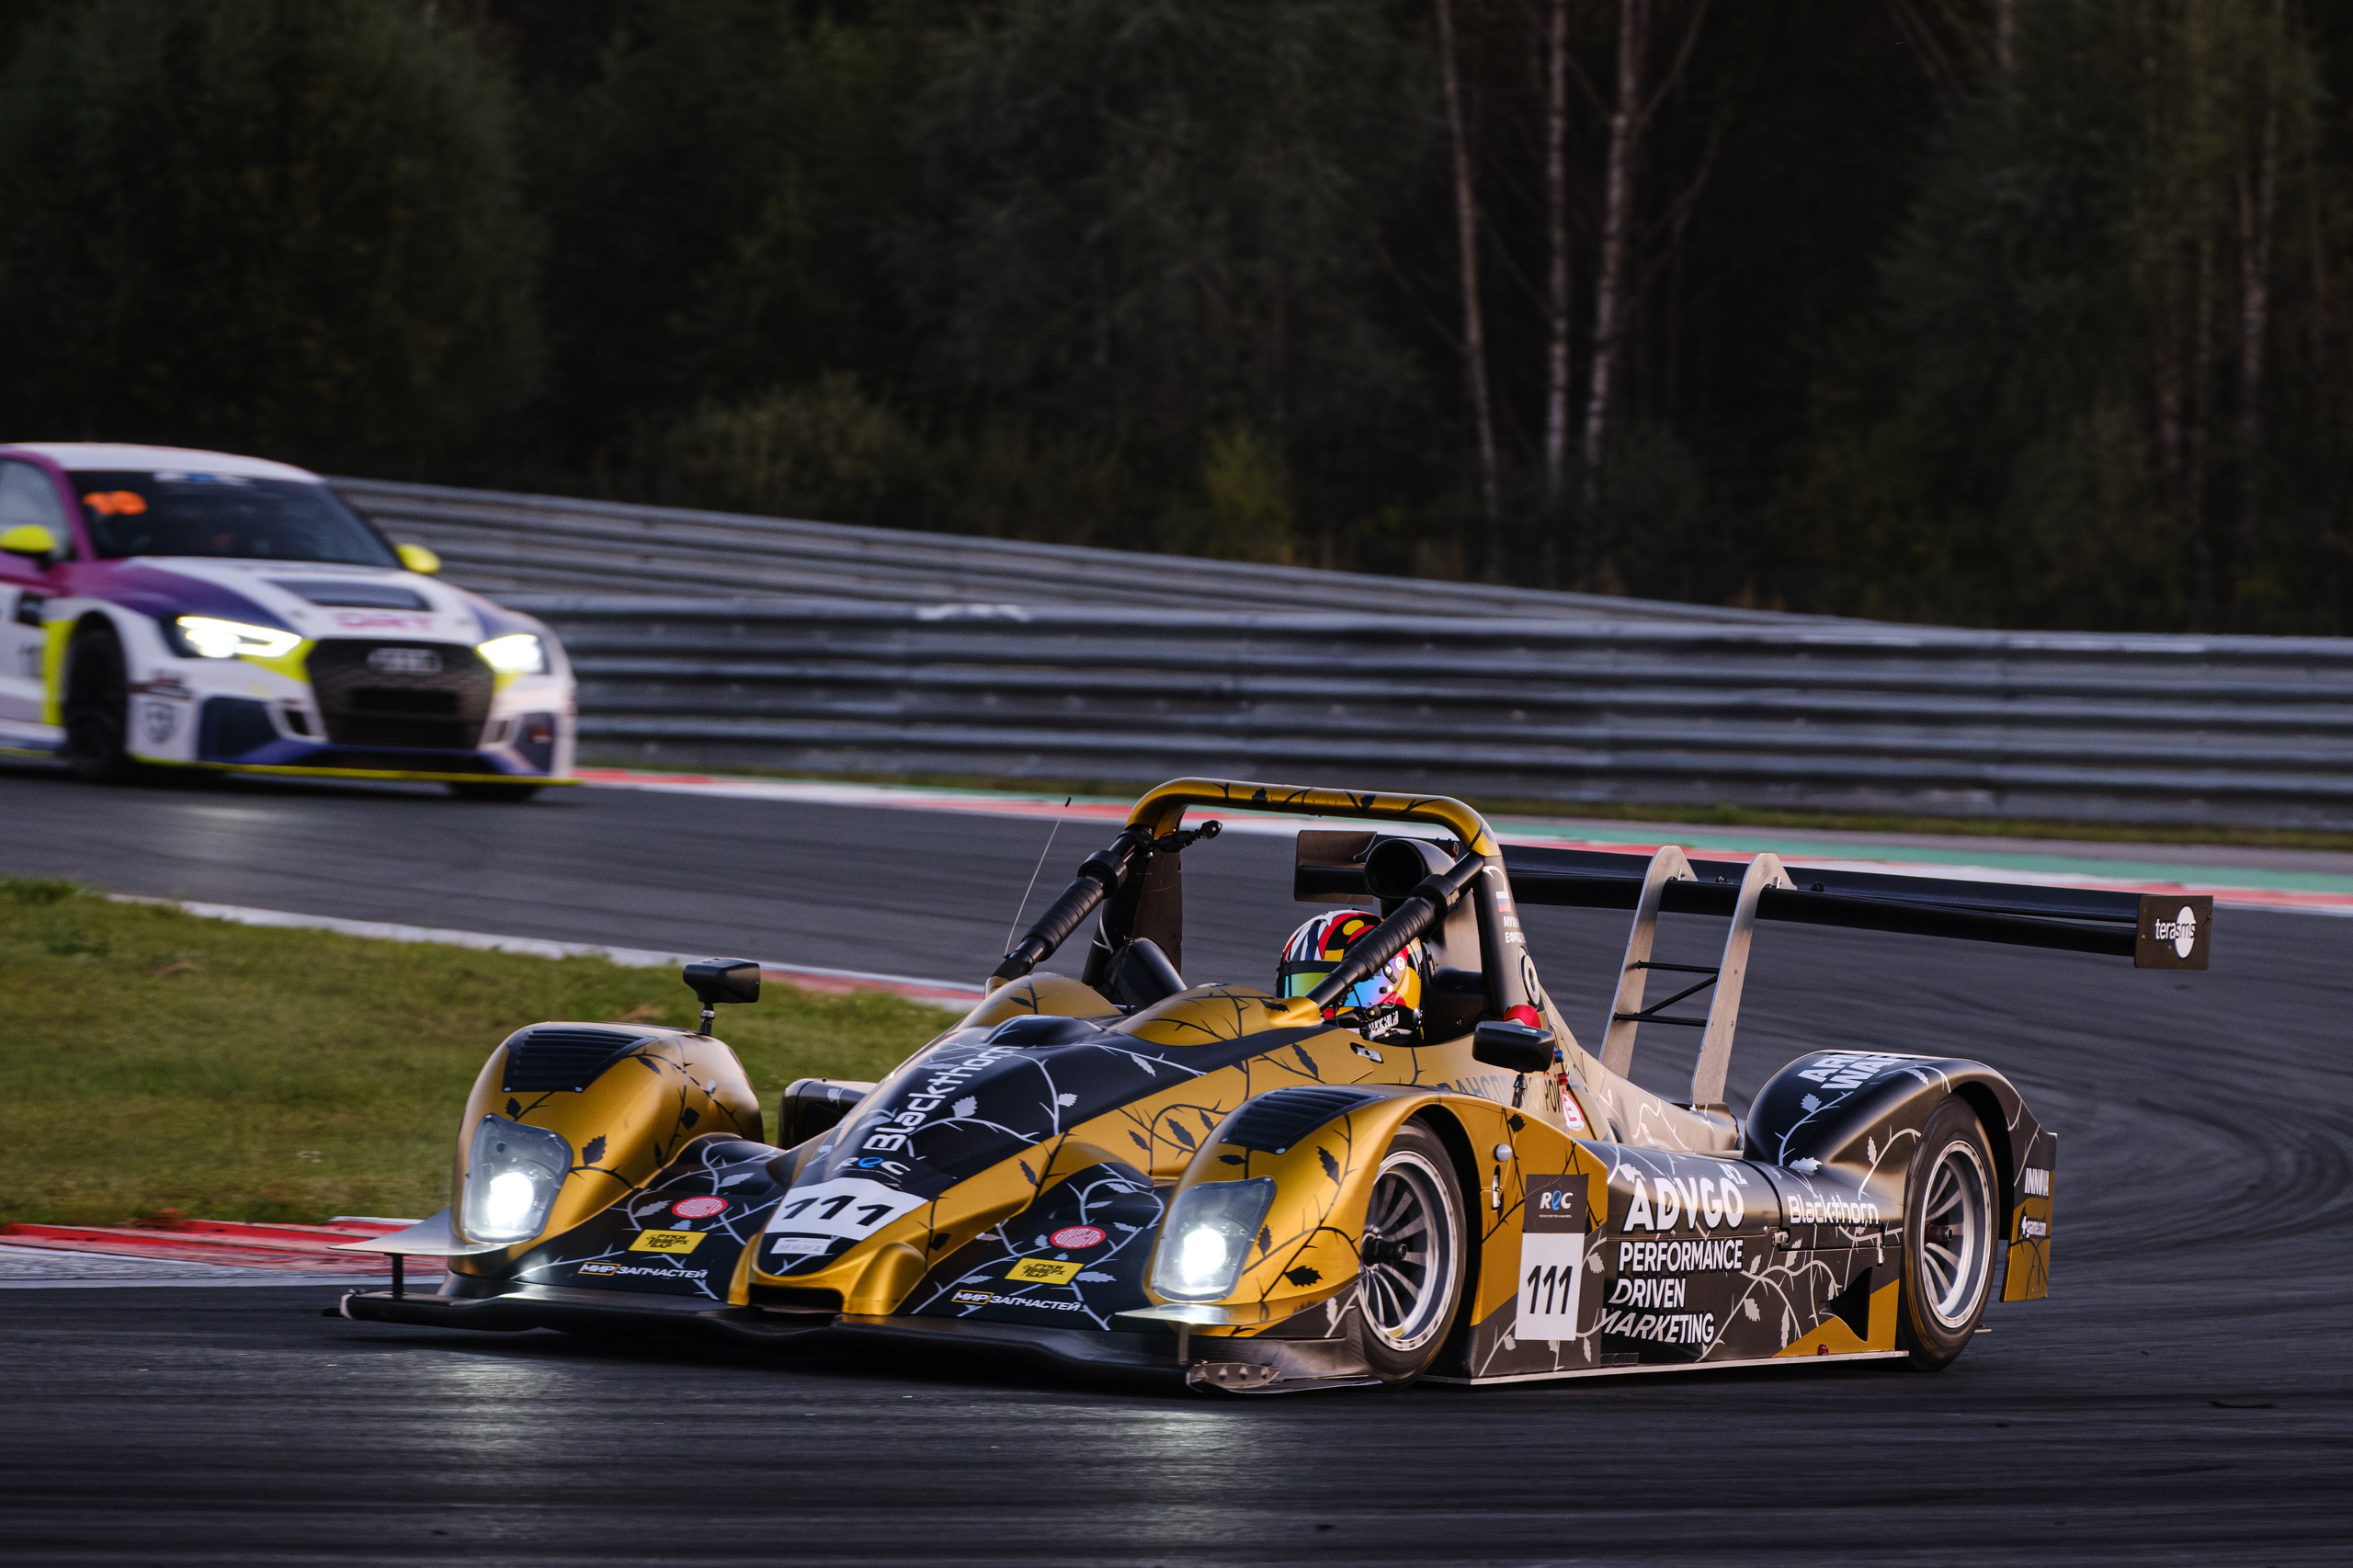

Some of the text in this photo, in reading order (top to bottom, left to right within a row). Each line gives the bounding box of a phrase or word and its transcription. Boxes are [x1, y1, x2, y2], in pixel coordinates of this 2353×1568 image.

[2154, 918, 2196, 939] terasms
[862, 1046, 1024, 1151] Blackthorn
[782, 1195, 894, 1227] 111
[1623, 1176, 1745, 1232] ADVGO
[1787, 1194, 1880, 1224] Blackthorn
[580, 1263, 709, 1278] МИР ЗАПЧАСТЕЙ
[1619, 1239, 1744, 1272] PERFORMANCE
[953, 1291, 1083, 1312] МИР ЗАПЧАСТЕЙ
[1527, 1265, 1574, 1315] 111
[1608, 1278, 1687, 1308] DRIVEN
[1602, 1307, 1715, 1344] MARKETING
